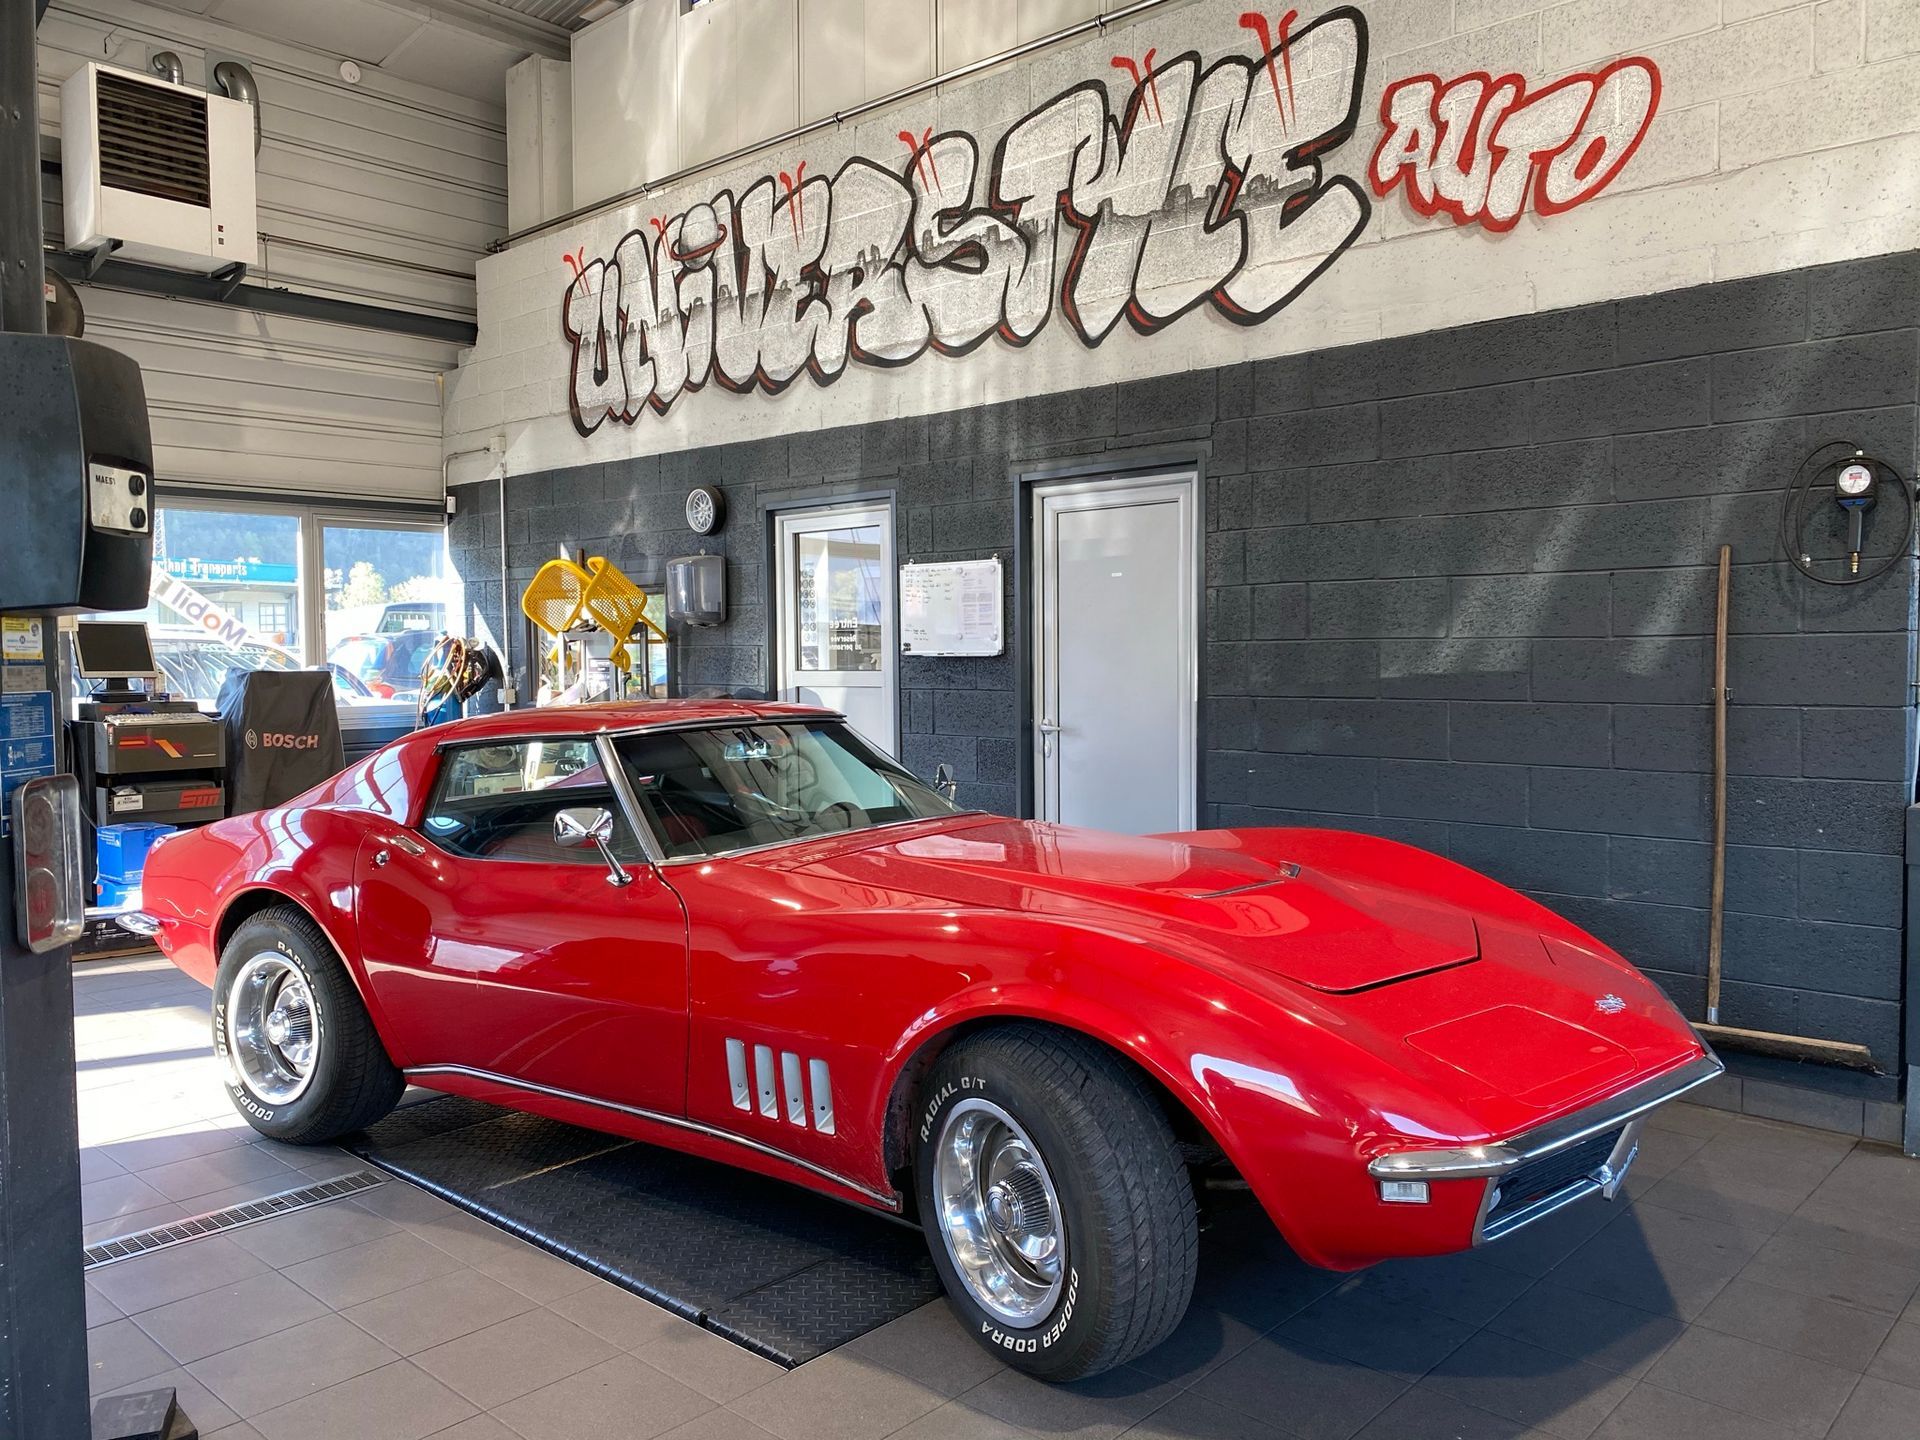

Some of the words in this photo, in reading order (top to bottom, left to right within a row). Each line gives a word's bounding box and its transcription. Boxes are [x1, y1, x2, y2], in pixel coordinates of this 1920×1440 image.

[1368, 56, 1661, 232] AUTO
[188, 558, 247, 575] Transports
[262, 732, 319, 750] BOSCH
[277, 941, 316, 997] RADIAL
[216, 1004, 229, 1056] OBRA
[232, 1085, 275, 1121] COOPE
[920, 1082, 958, 1143] RADIAL
[960, 1076, 987, 1090] G/T
[1042, 1267, 1079, 1348] COOPER
[981, 1321, 1037, 1353] COBRA
